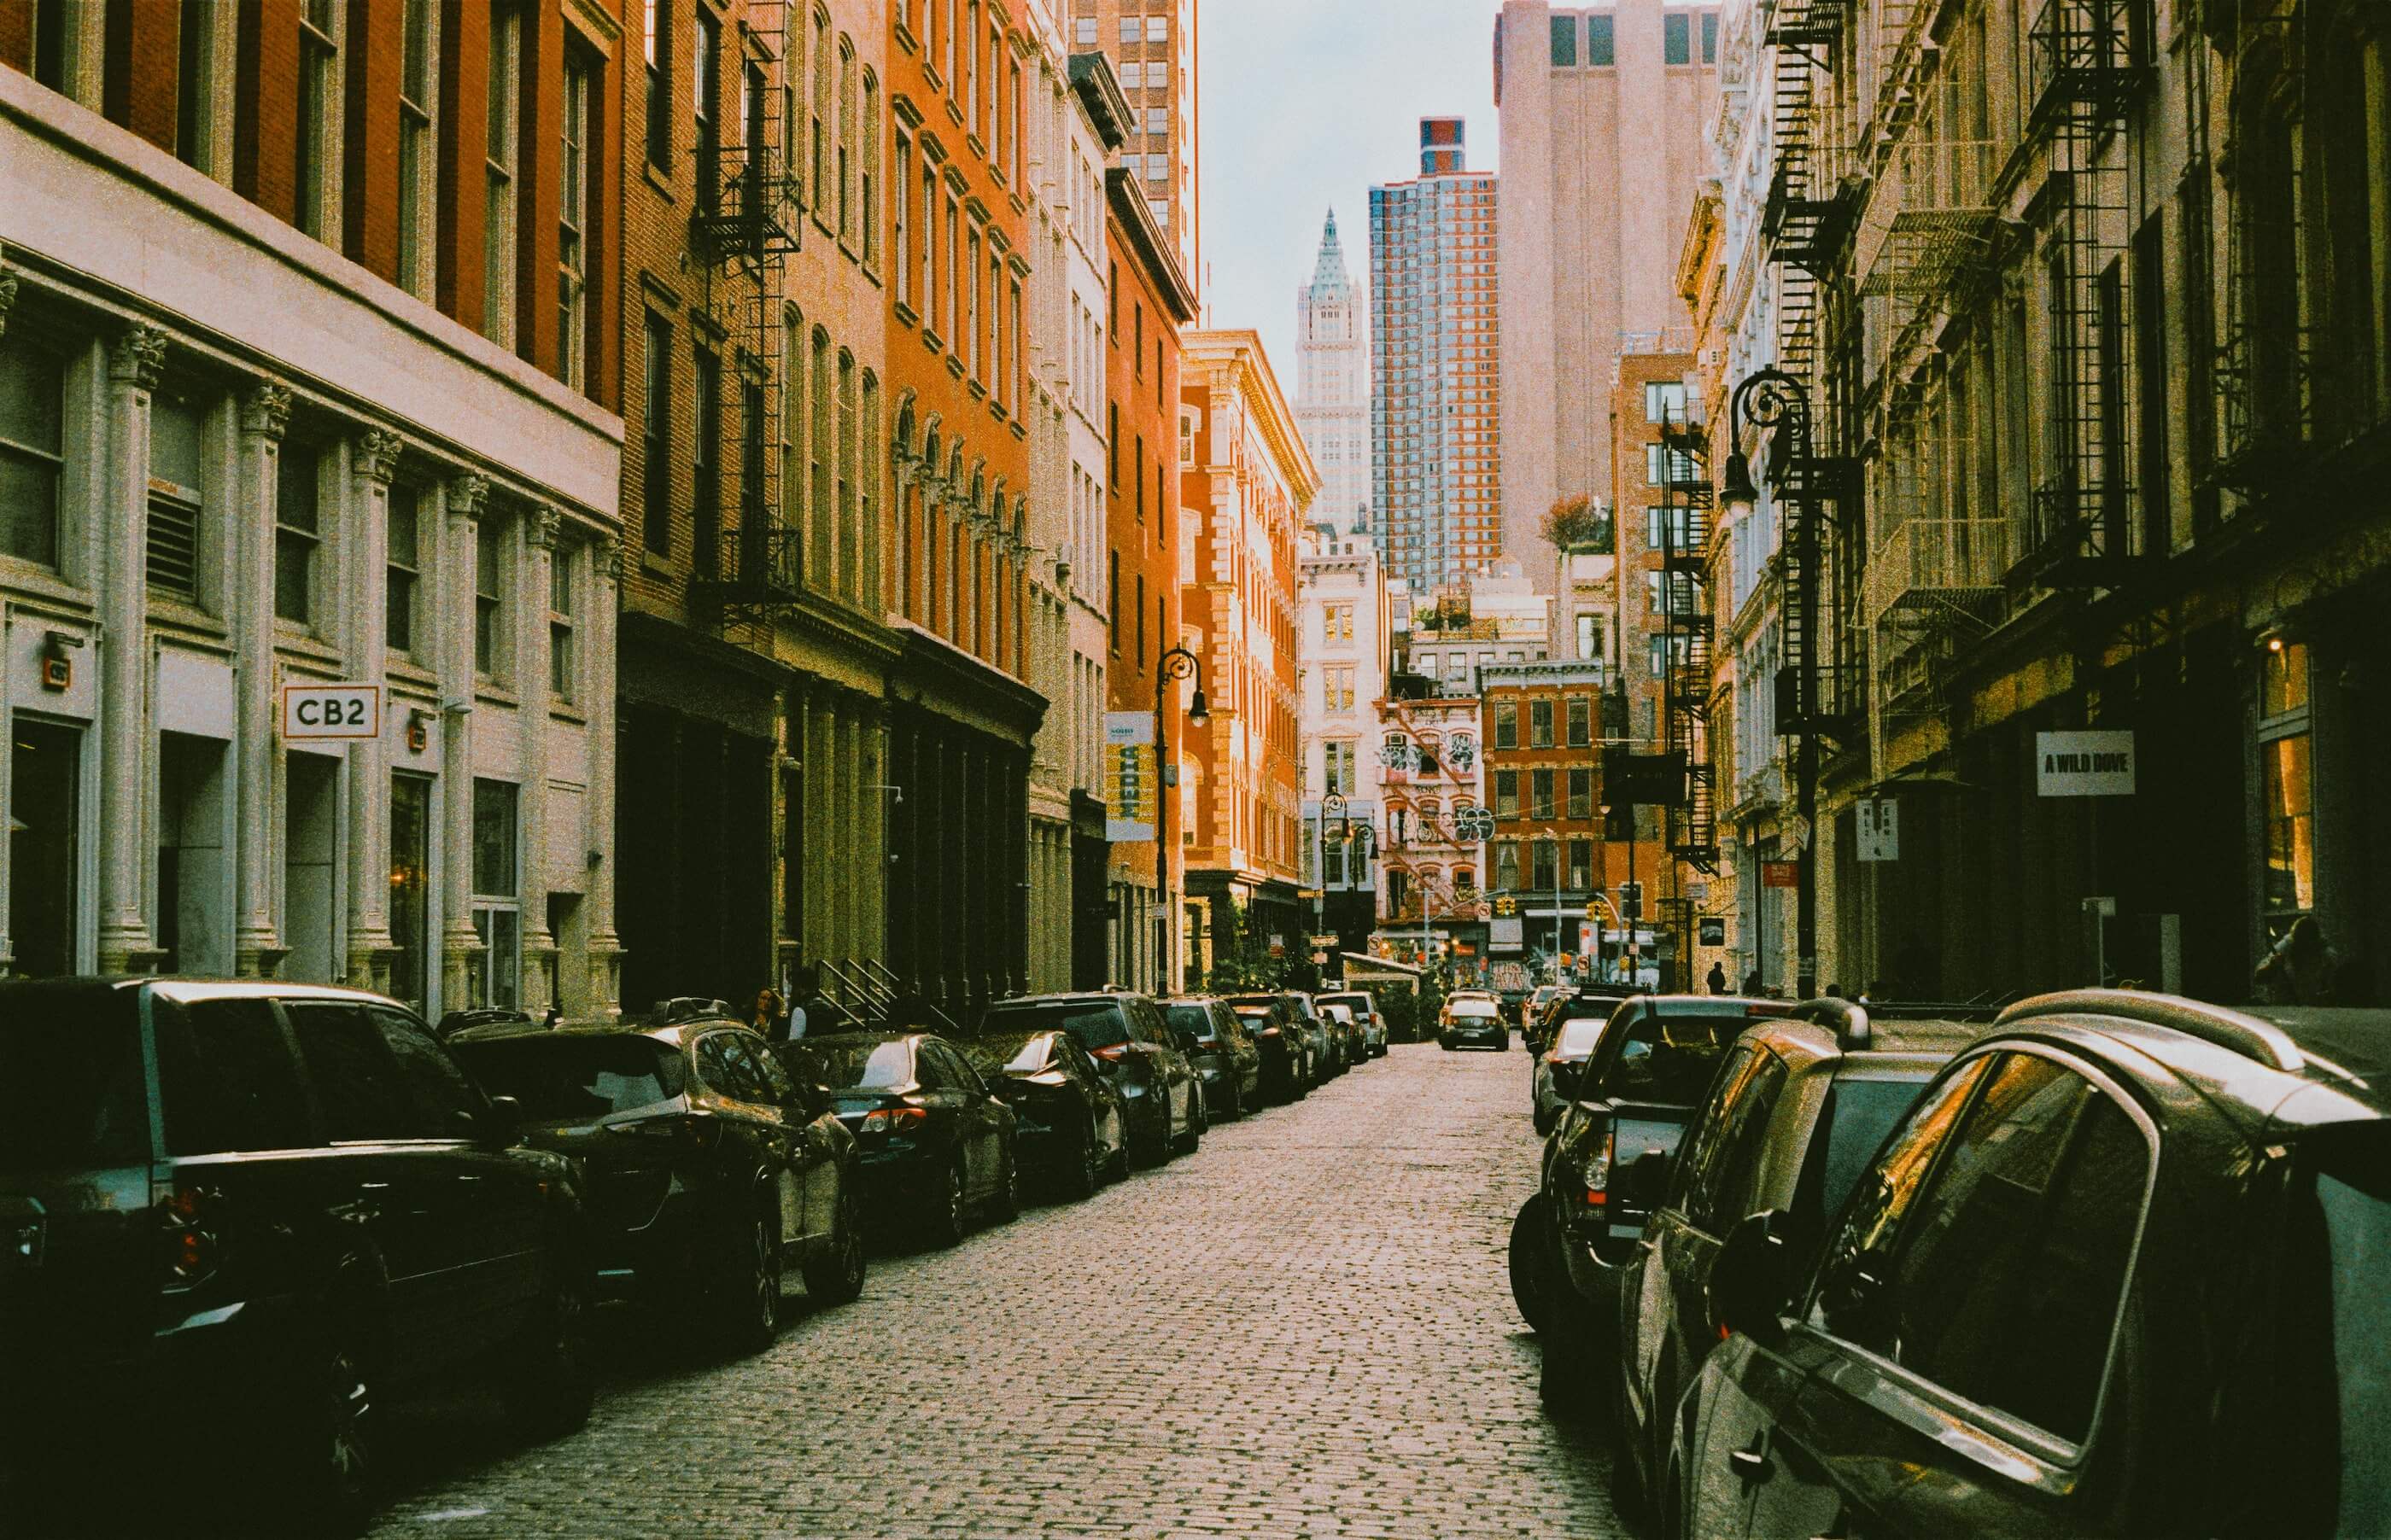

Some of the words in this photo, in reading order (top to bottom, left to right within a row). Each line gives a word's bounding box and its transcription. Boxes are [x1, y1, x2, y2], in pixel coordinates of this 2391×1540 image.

[297, 698, 365, 726] CB2
[2045, 754, 2055, 773] A
[2056, 754, 2090, 773] WILD
[2093, 753, 2129, 773] DOVE
